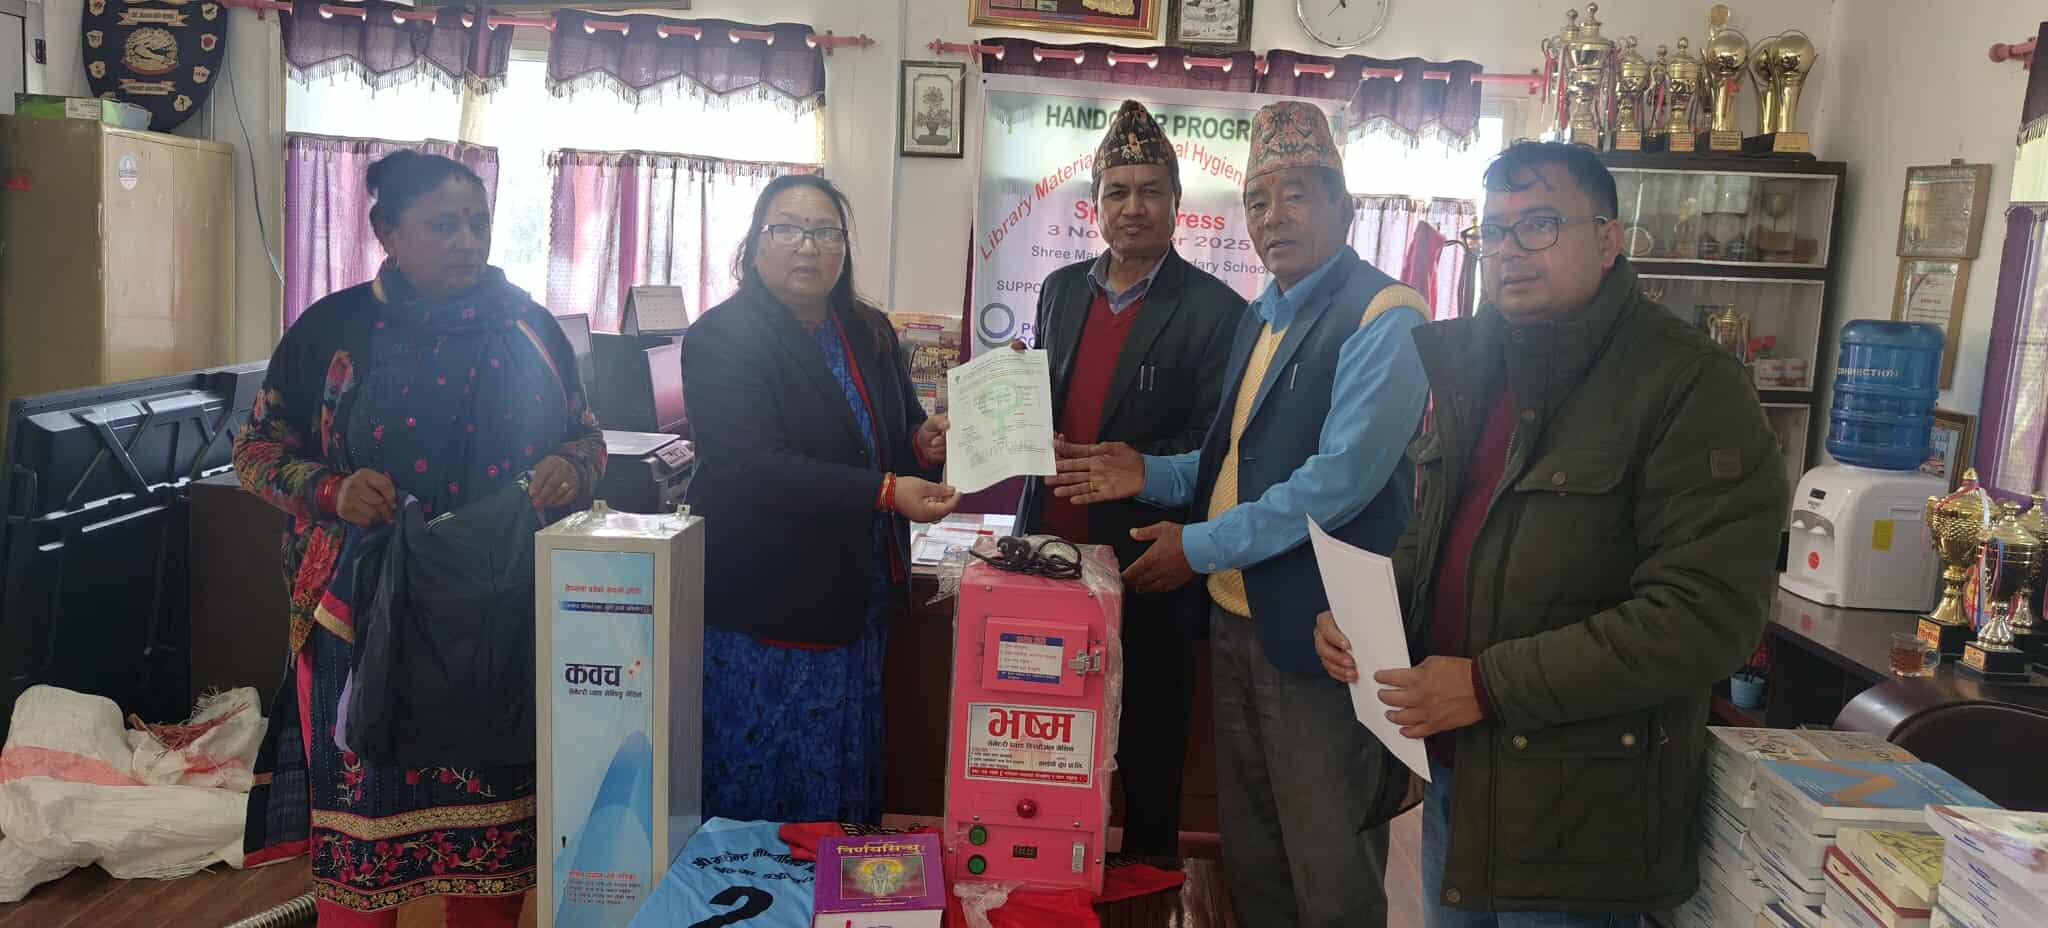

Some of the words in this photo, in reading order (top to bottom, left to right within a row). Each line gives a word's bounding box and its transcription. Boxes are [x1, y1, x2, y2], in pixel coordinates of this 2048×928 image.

[980, 193, 1032, 261] Library
[1176, 213, 1225, 231] ress
[1048, 225, 1060, 236] 3
[1194, 236, 1250, 250] 2025
[1031, 245, 1071, 260] Shree
[1223, 260, 1265, 274] Schoo
[996, 280, 1041, 294] SUPPO
[565, 663, 623, 686] कवच
[988, 708, 1076, 743] भष्म
[688, 886, 774, 928] 2
